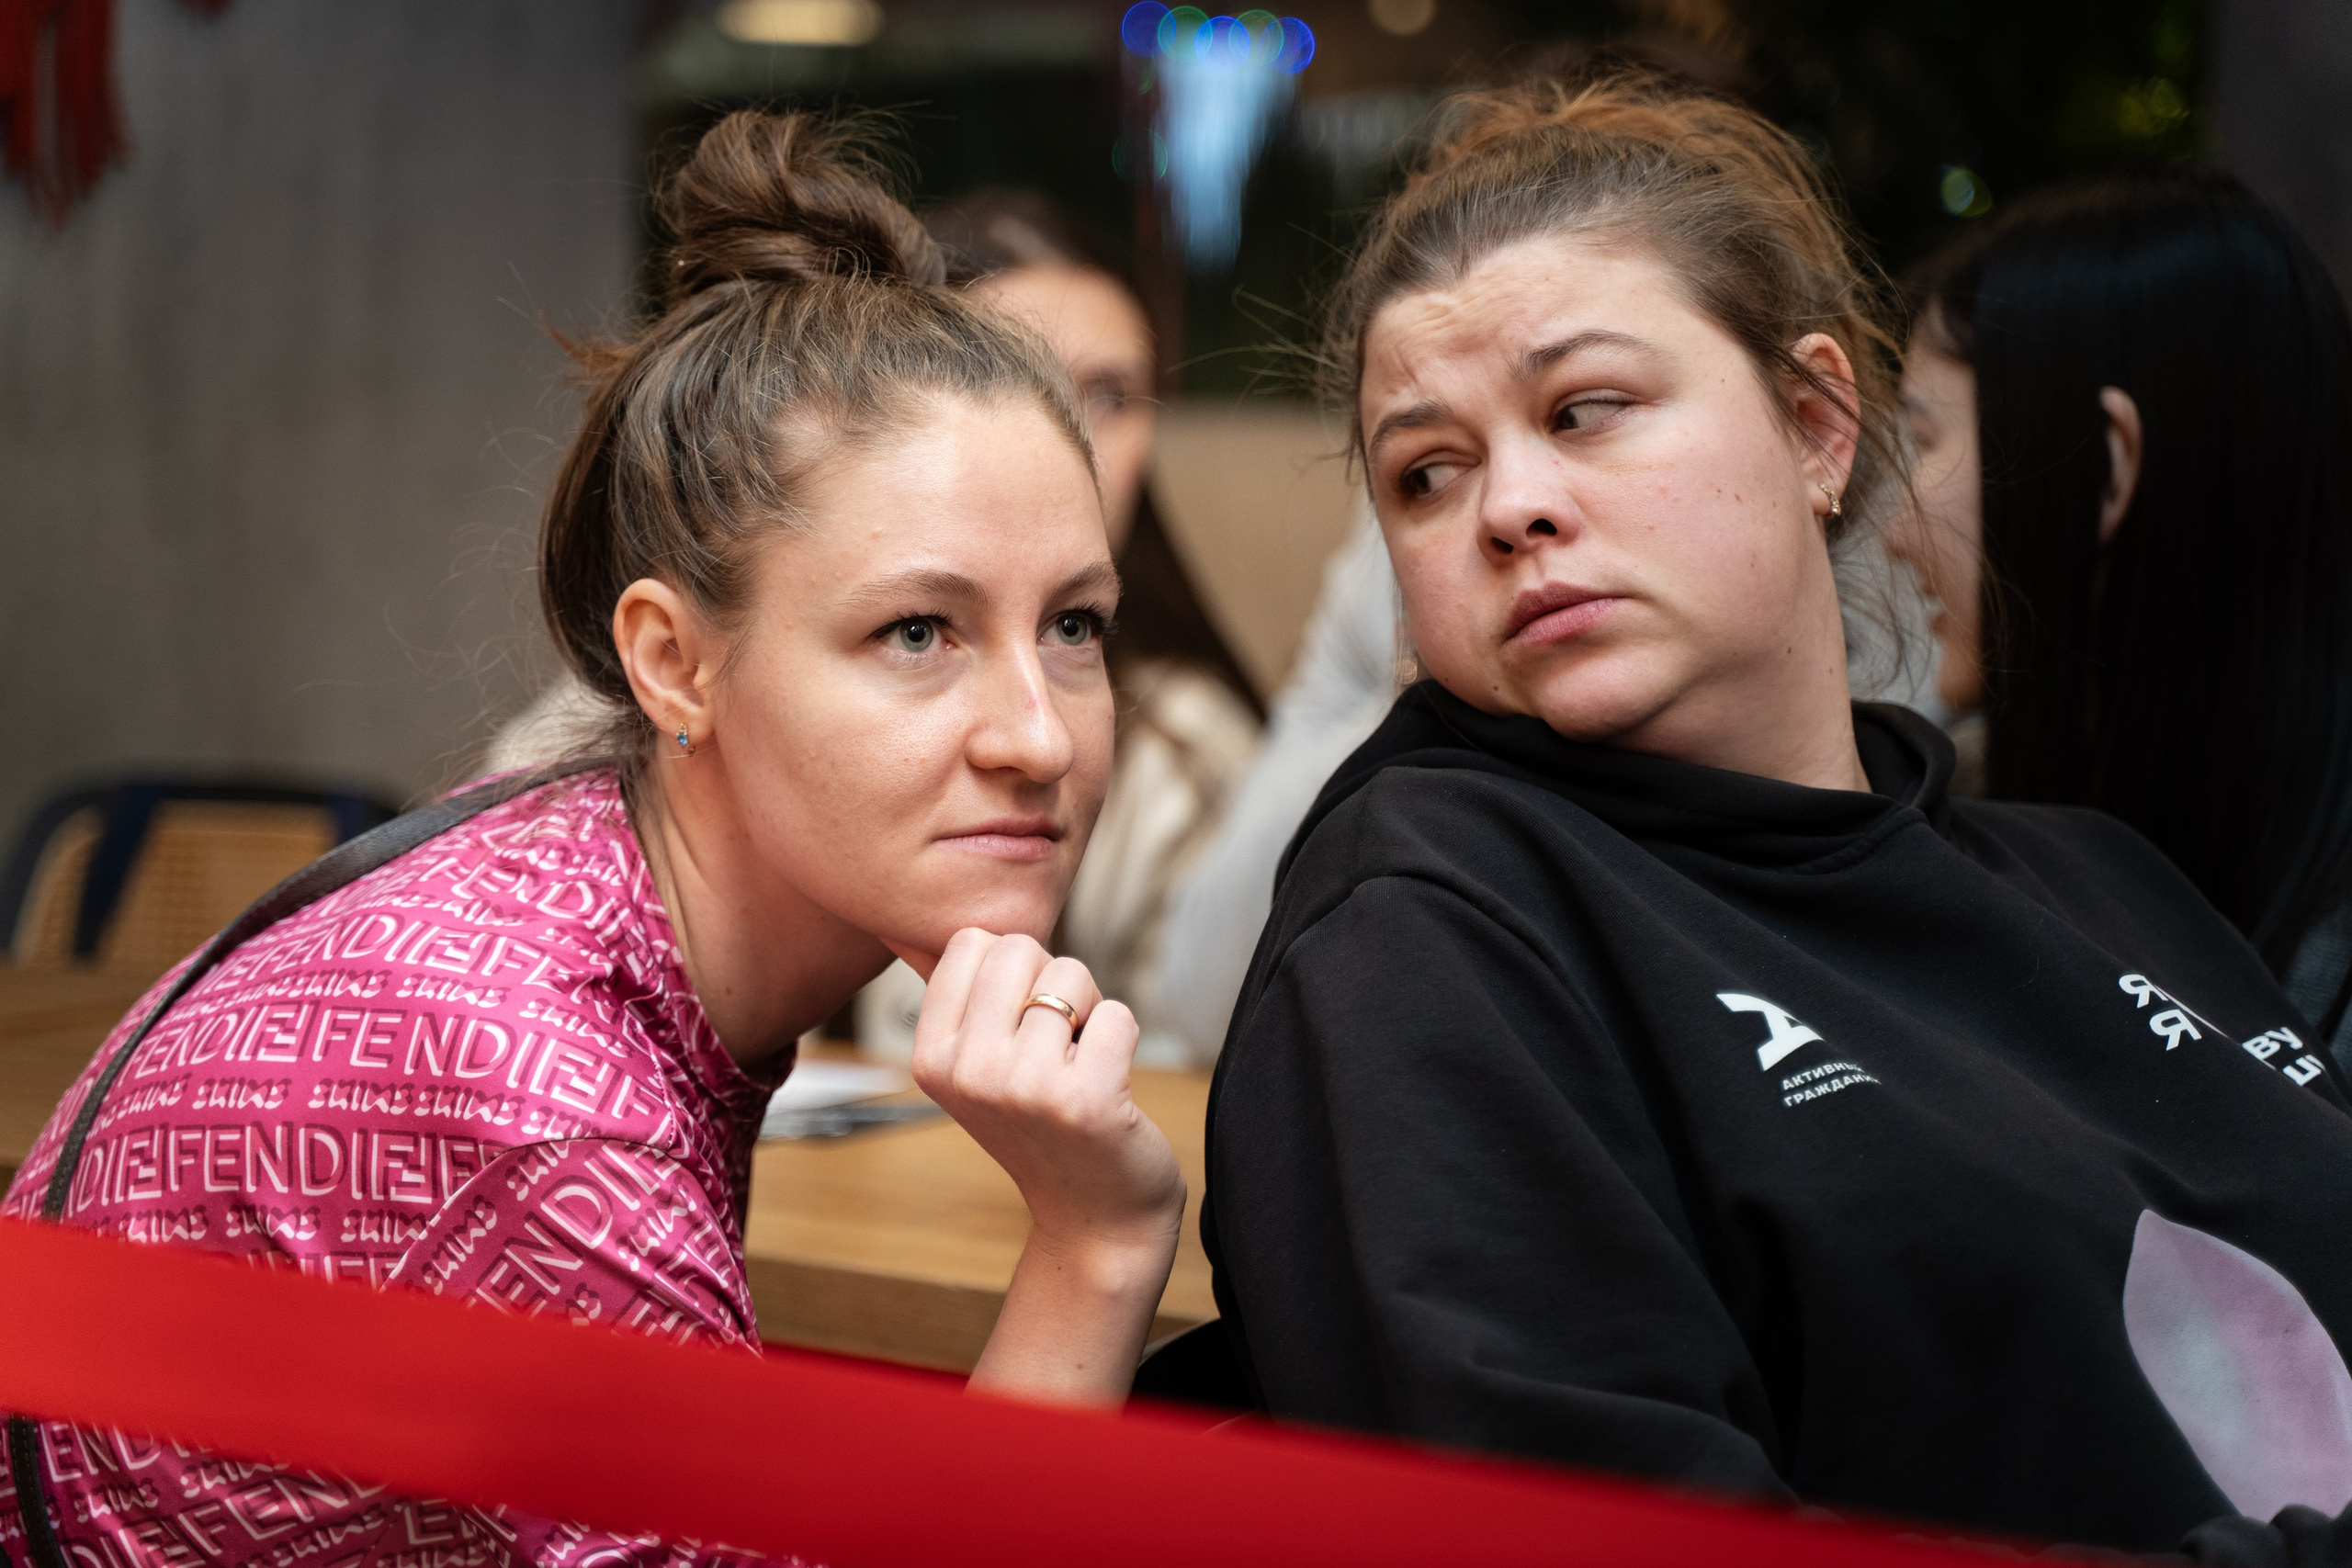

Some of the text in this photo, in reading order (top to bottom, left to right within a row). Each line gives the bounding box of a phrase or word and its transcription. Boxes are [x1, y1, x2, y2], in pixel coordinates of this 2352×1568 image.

[311, 1003, 547, 1089] FENDI
[168, 1119, 372, 1200] FENDI
[463, 1148, 642, 1323] ENDI
